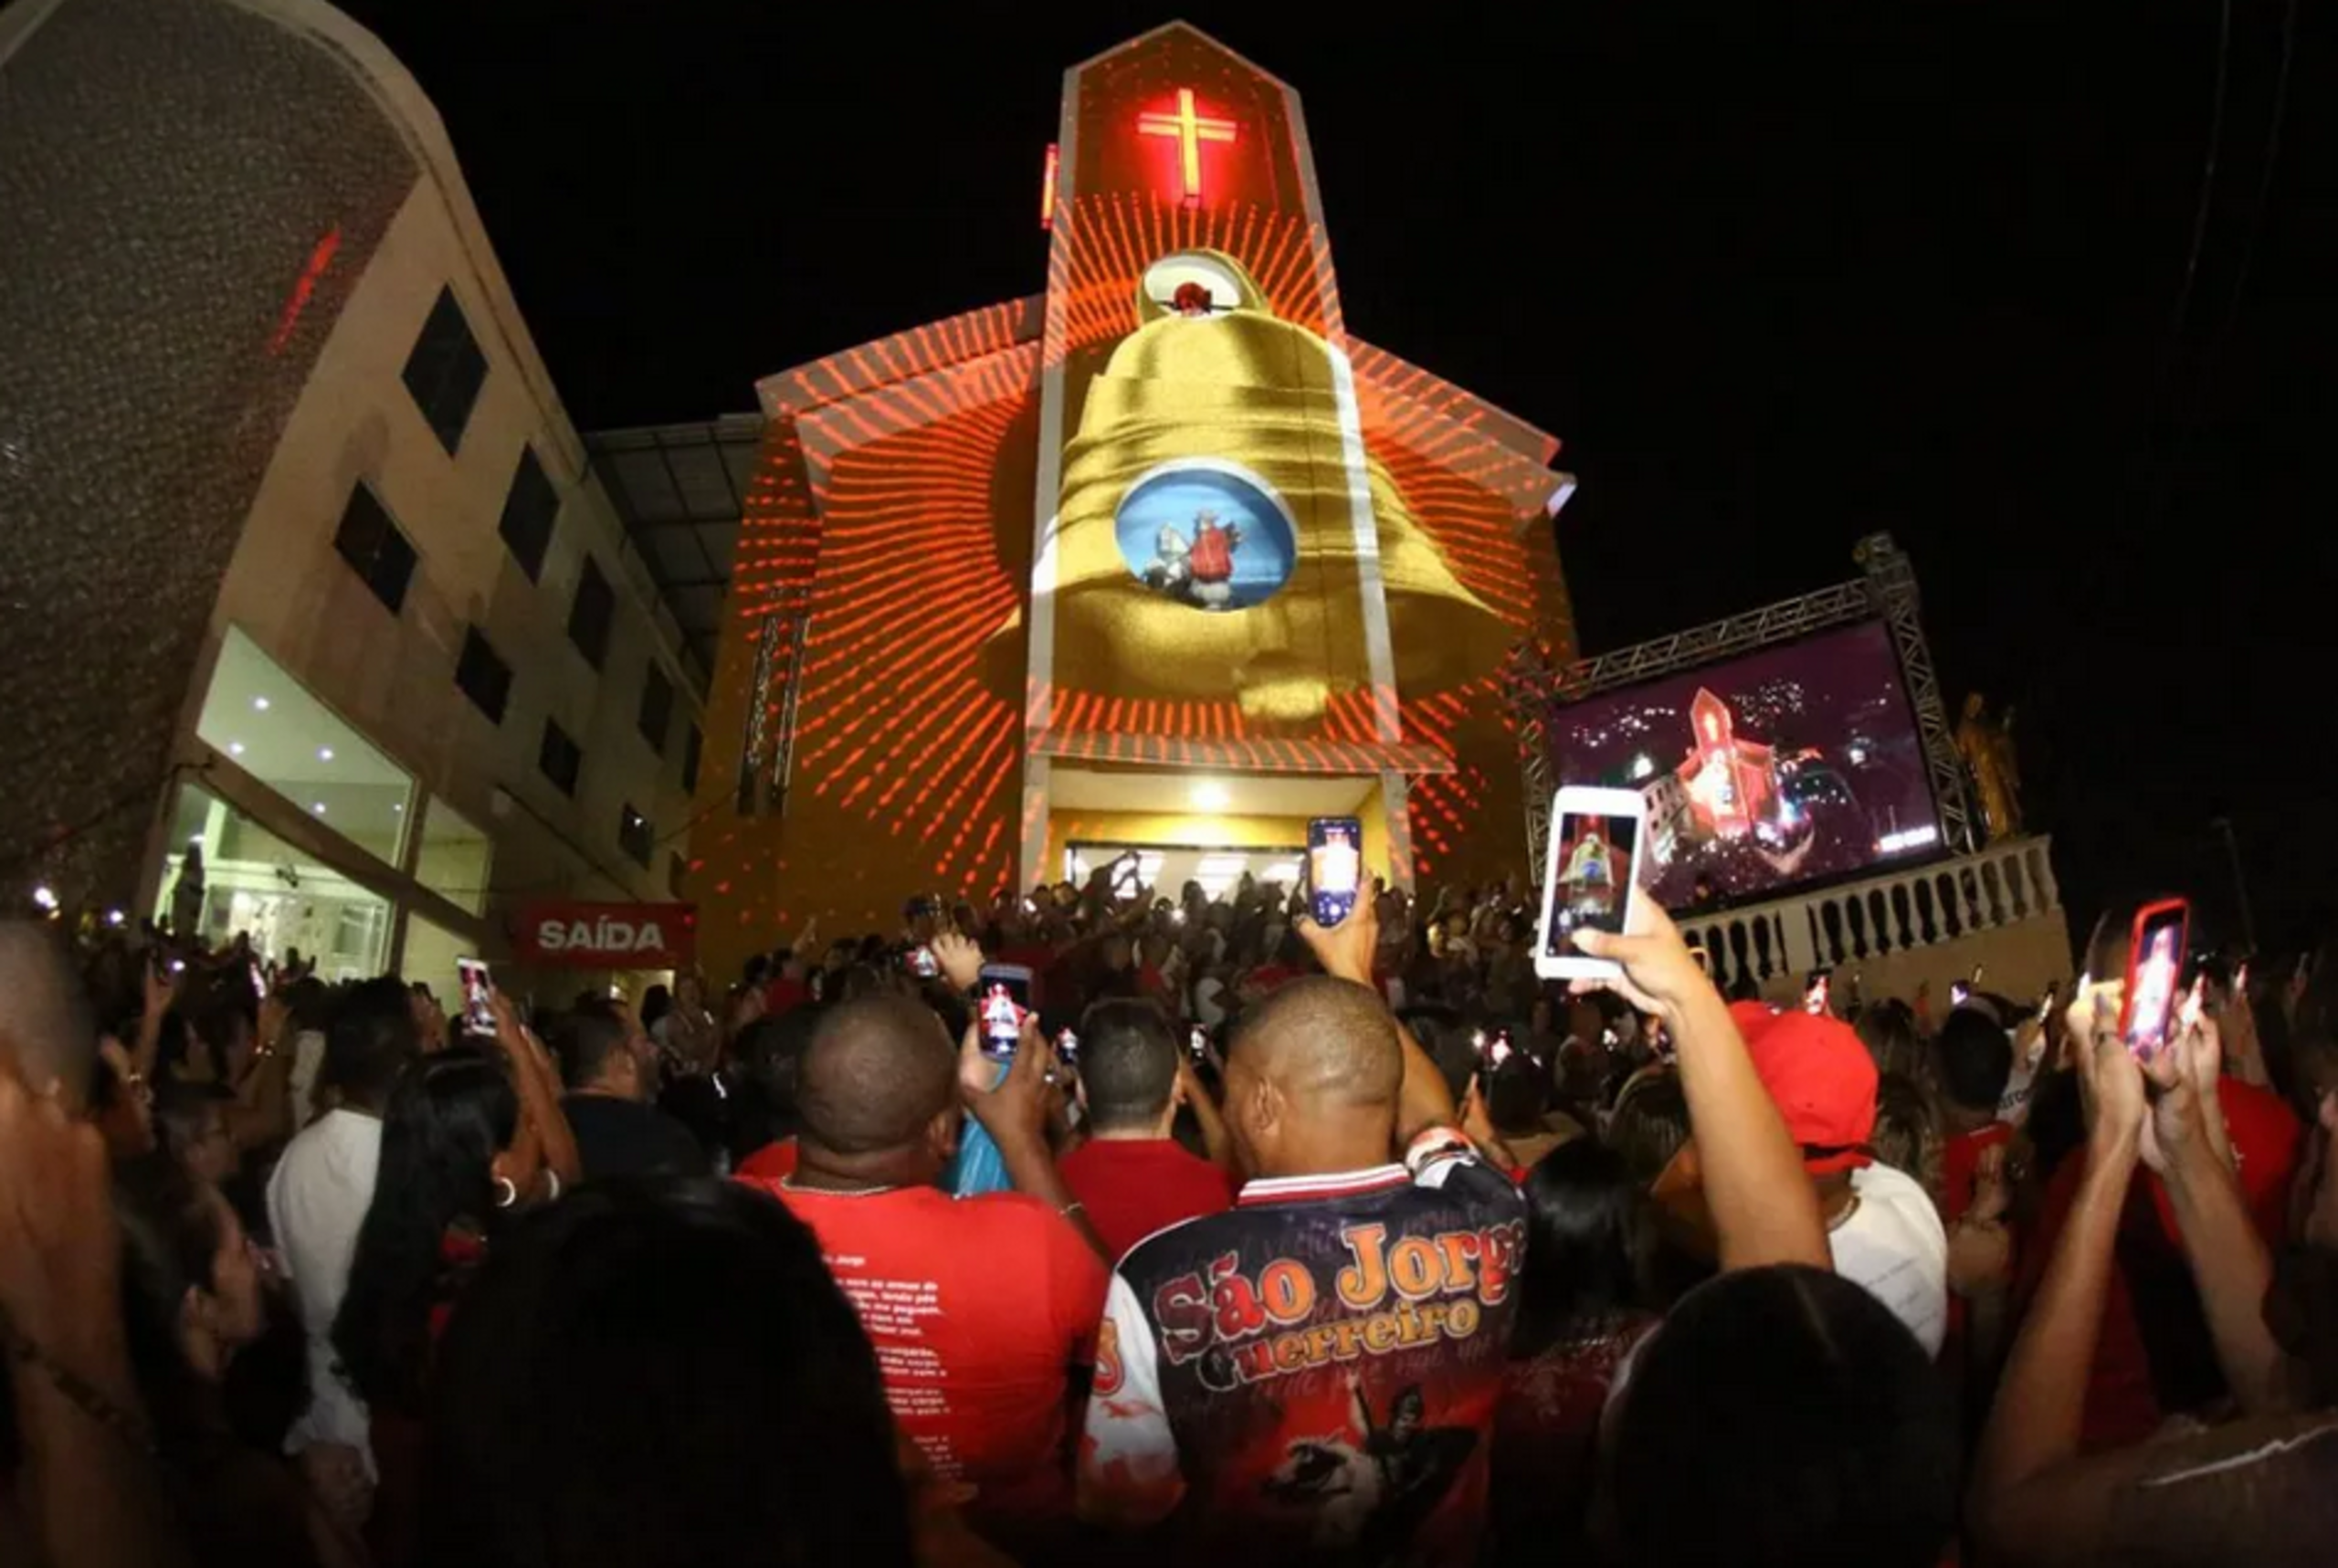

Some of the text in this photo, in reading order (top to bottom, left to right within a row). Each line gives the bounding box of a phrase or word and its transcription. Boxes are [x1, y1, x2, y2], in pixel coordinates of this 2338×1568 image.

[537, 914, 665, 952] SAÍDA
[1153, 1250, 1316, 1365] São
[1196, 1299, 1480, 1391] Guerreiro
